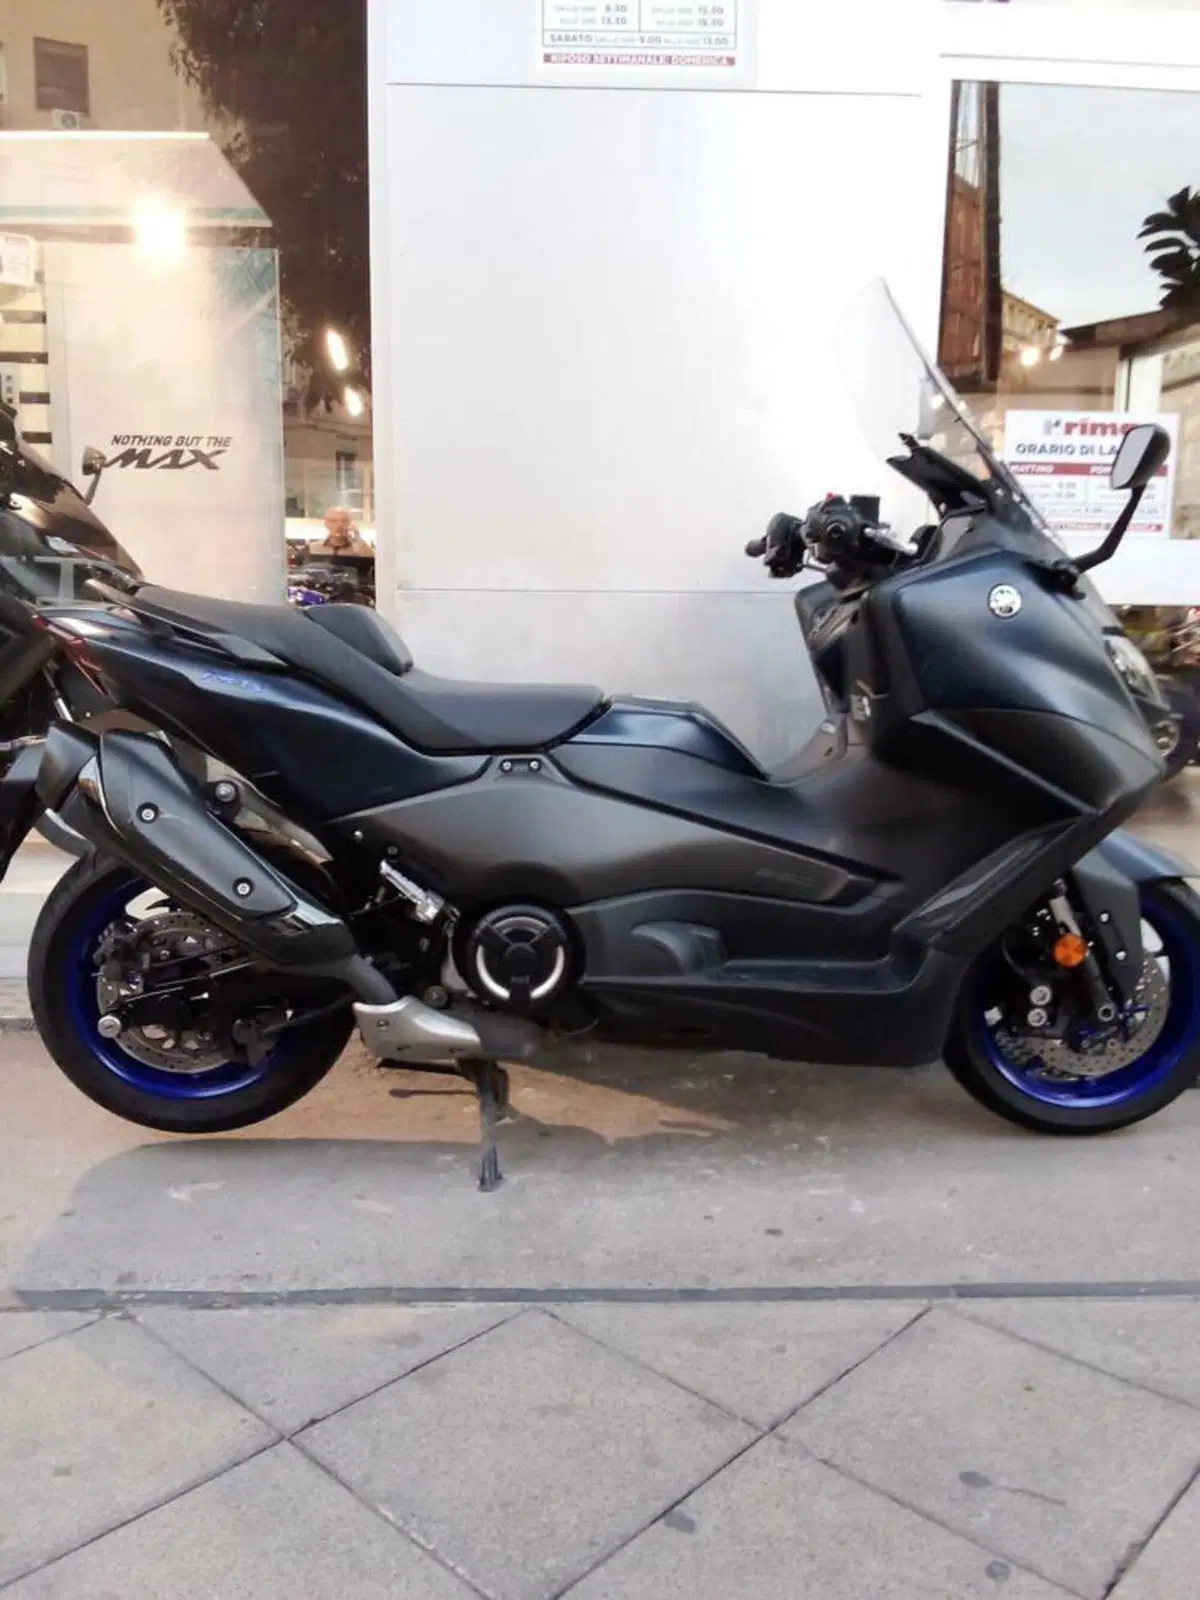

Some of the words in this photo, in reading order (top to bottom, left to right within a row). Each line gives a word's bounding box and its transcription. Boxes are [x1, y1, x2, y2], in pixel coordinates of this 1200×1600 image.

[550, 33, 593, 42] SABATO
[111, 434, 171, 446] NOTHING
[175, 436, 203, 447] BUT
[206, 436, 233, 447] THE
[1015, 443, 1075, 456] ORARIO
[1079, 444, 1095, 456] DI
[102, 448, 228, 470] MAX
